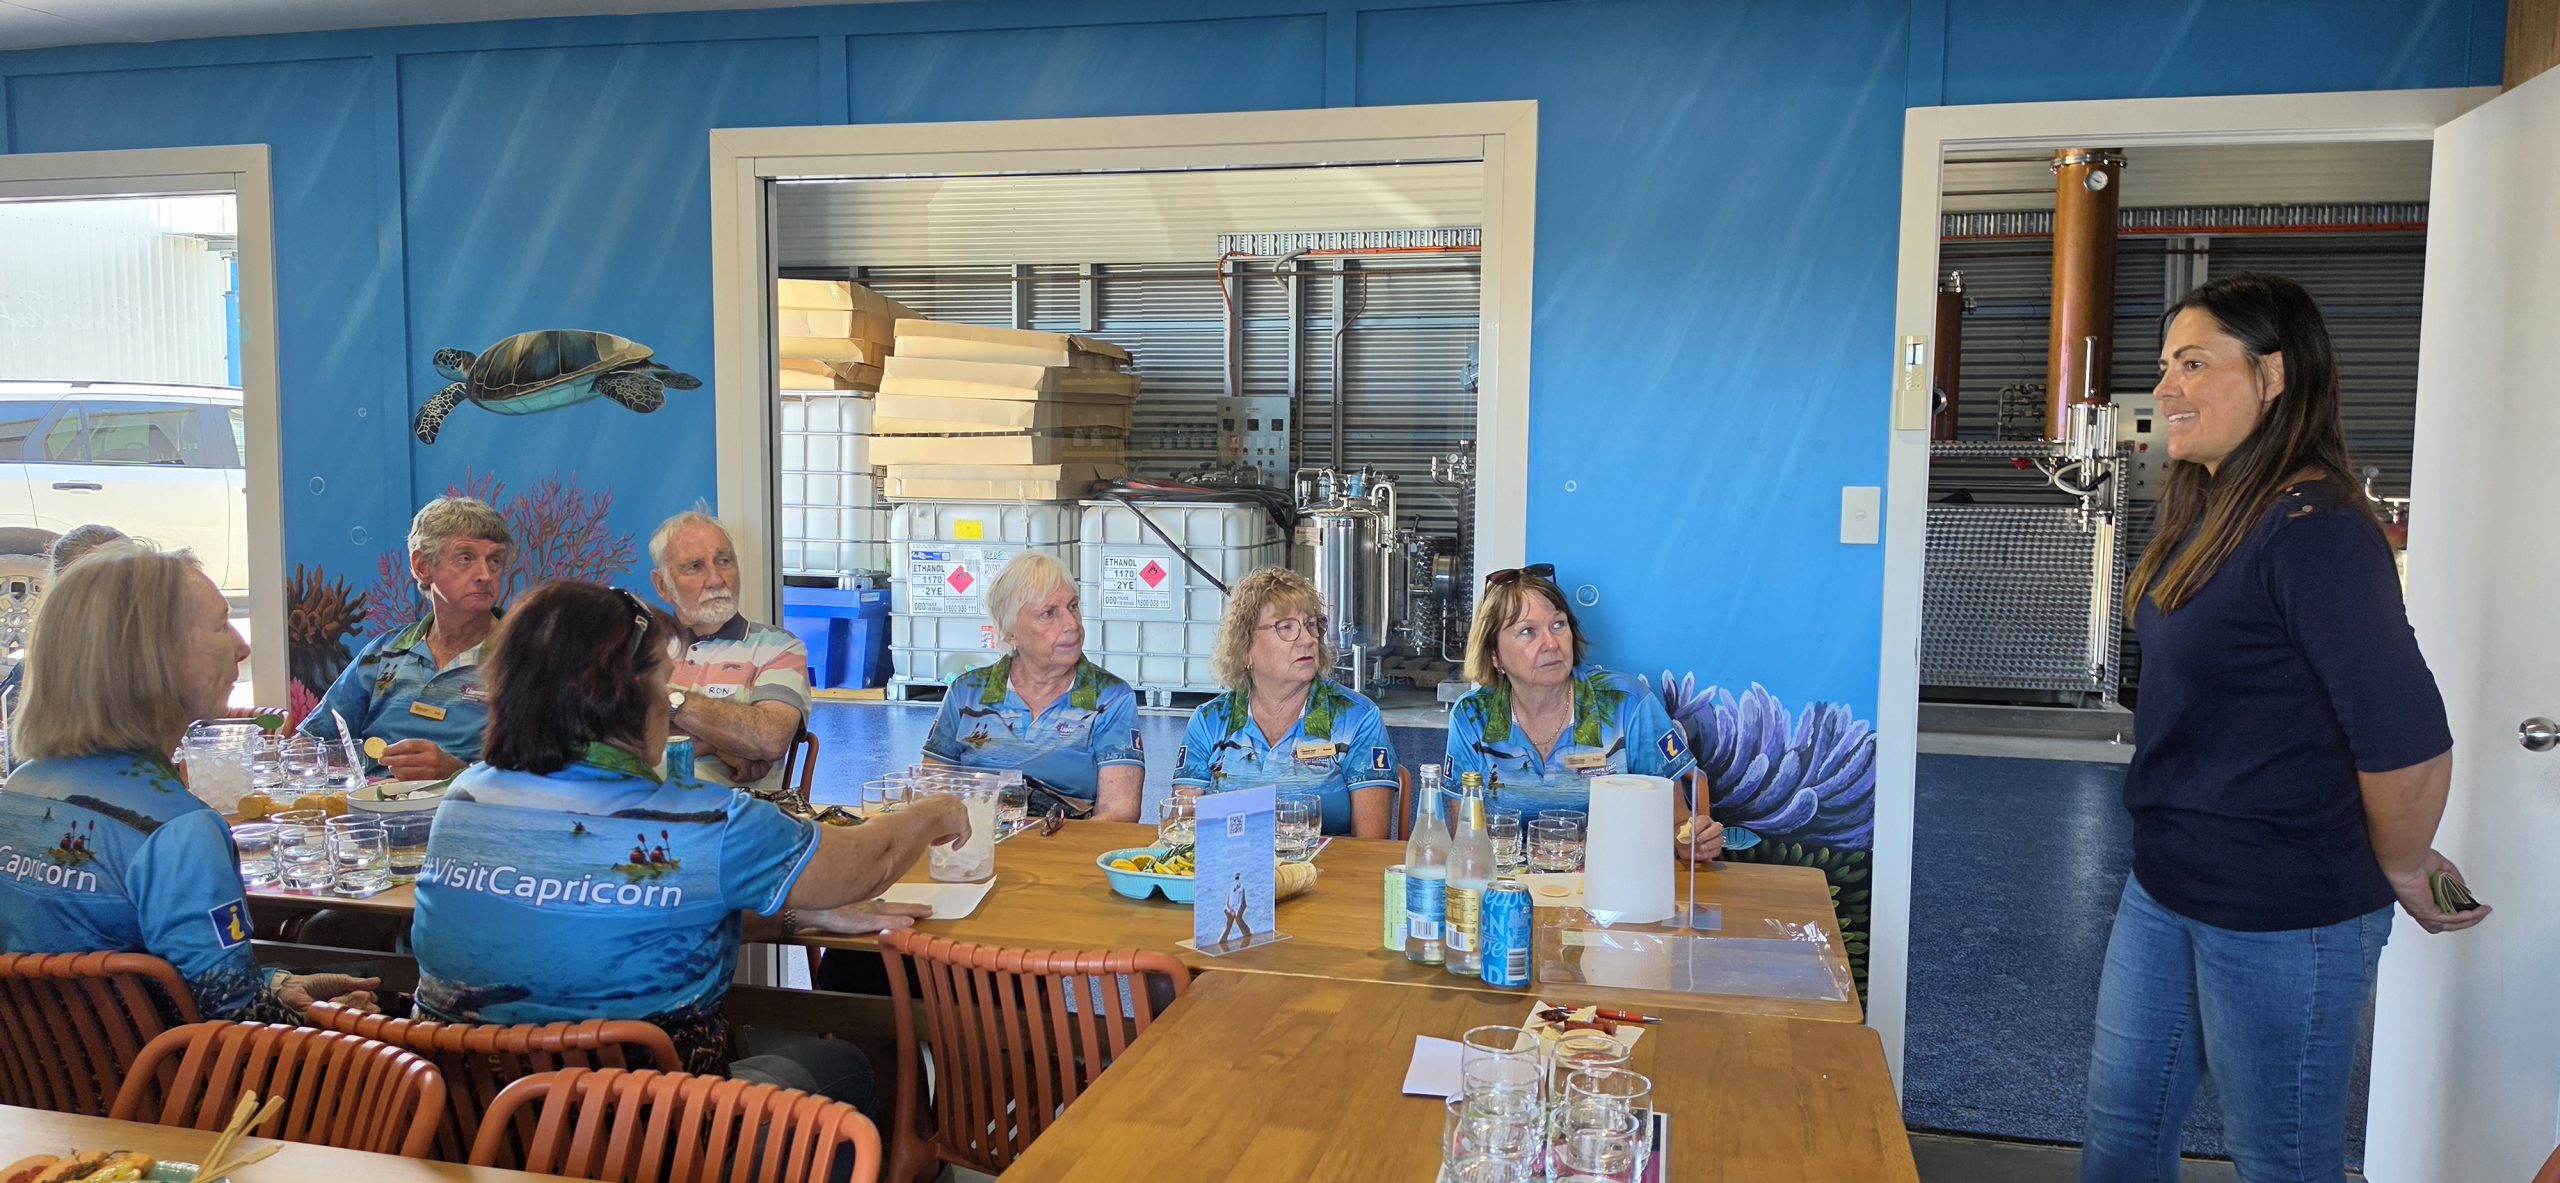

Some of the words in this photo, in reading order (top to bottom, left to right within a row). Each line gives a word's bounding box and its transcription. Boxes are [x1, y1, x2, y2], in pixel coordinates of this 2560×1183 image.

[1104, 558, 1137, 567] ETHANOL
[913, 564, 945, 573] ETHANOL
[1114, 569, 1135, 578] 1170
[922, 575, 943, 584] 1170
[708, 686, 730, 695] RON
[416, 856, 683, 908] #VisitCapricorn
